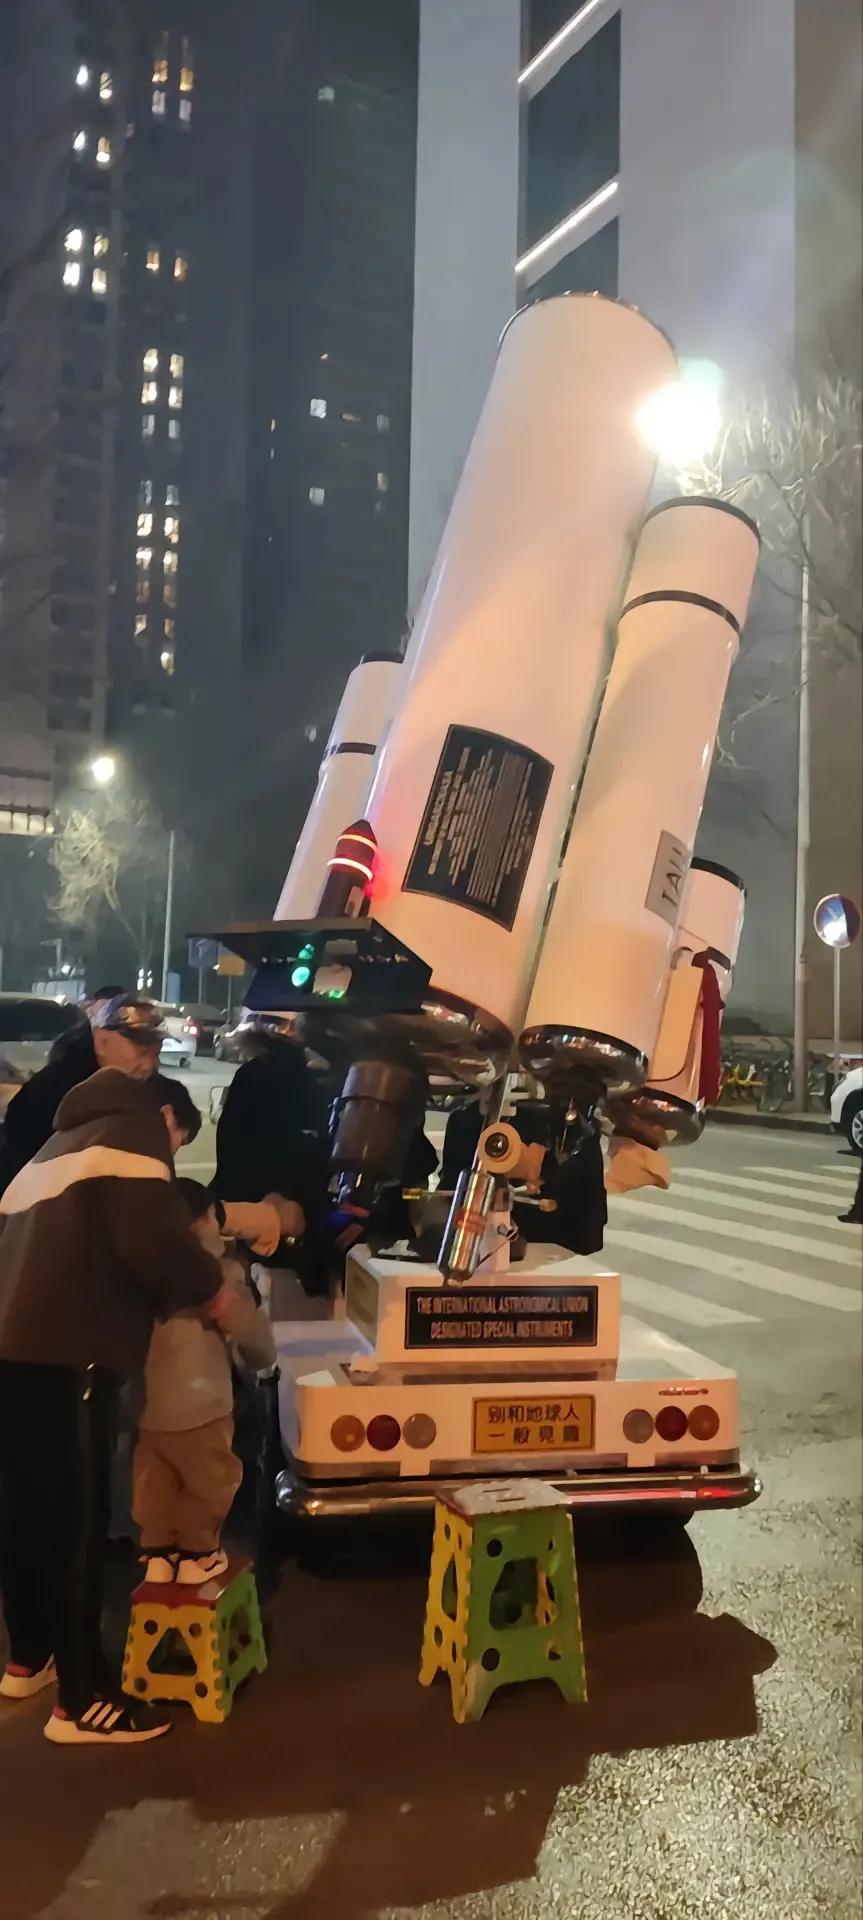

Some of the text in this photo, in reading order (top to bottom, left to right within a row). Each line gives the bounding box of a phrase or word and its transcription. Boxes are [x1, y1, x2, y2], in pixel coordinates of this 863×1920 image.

[417, 1297, 432, 1314] THE
[432, 1296, 497, 1314] INTERNATIONAL
[562, 1296, 589, 1313] UNION
[431, 1320, 573, 1339] DESIGNATED SPECIAL INSTRUMENTS
[488, 1403, 580, 1424] 别和地球人
